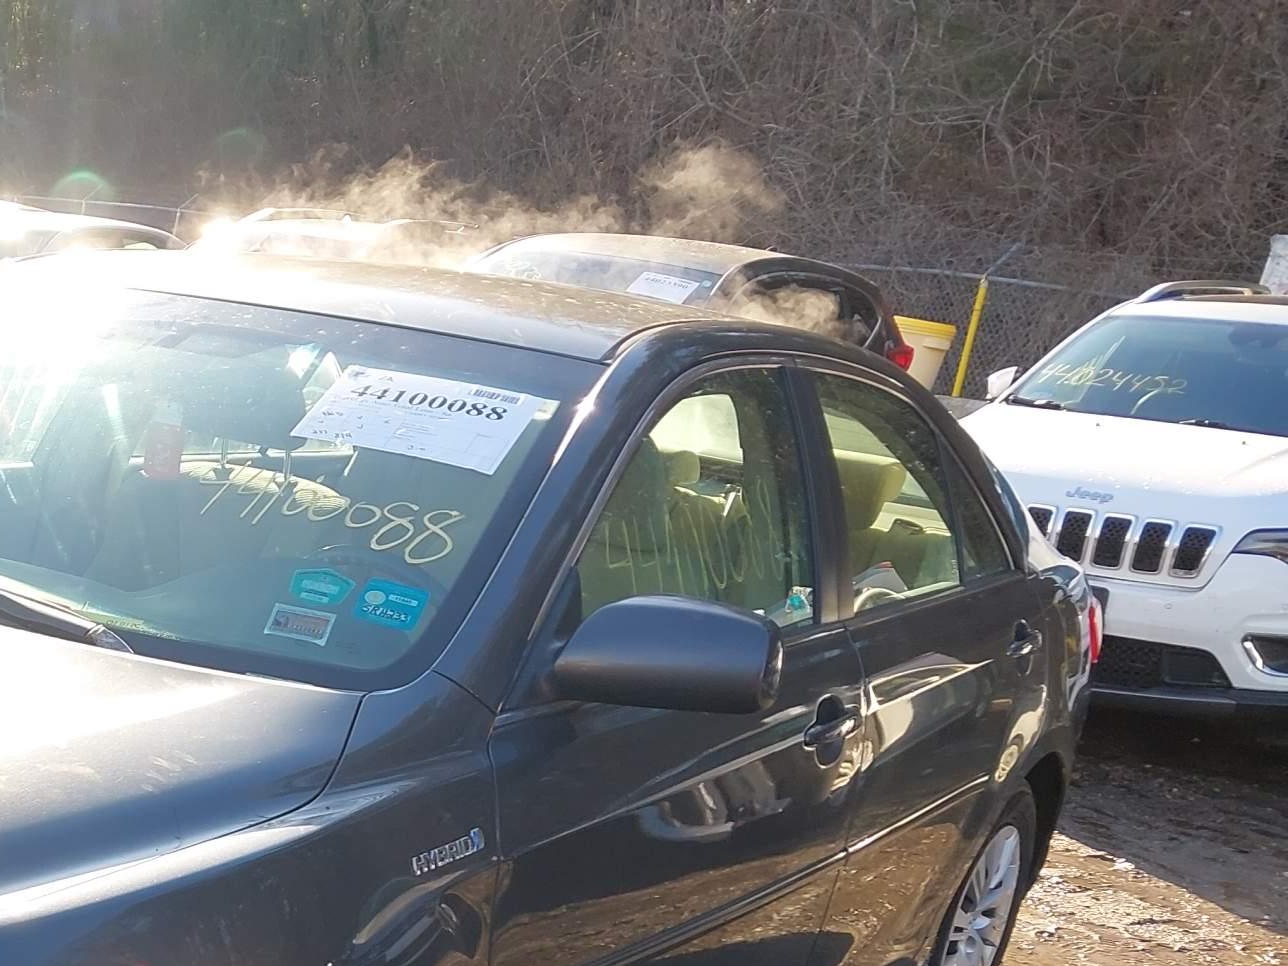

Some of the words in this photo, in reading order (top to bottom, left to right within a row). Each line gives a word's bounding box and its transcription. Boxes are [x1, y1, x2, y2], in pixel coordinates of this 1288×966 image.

[350, 384, 509, 421] 44100088
[200, 460, 465, 564] 44100088
[1065, 485, 1115, 504] Jeep
[412, 835, 473, 876] HYBRID
